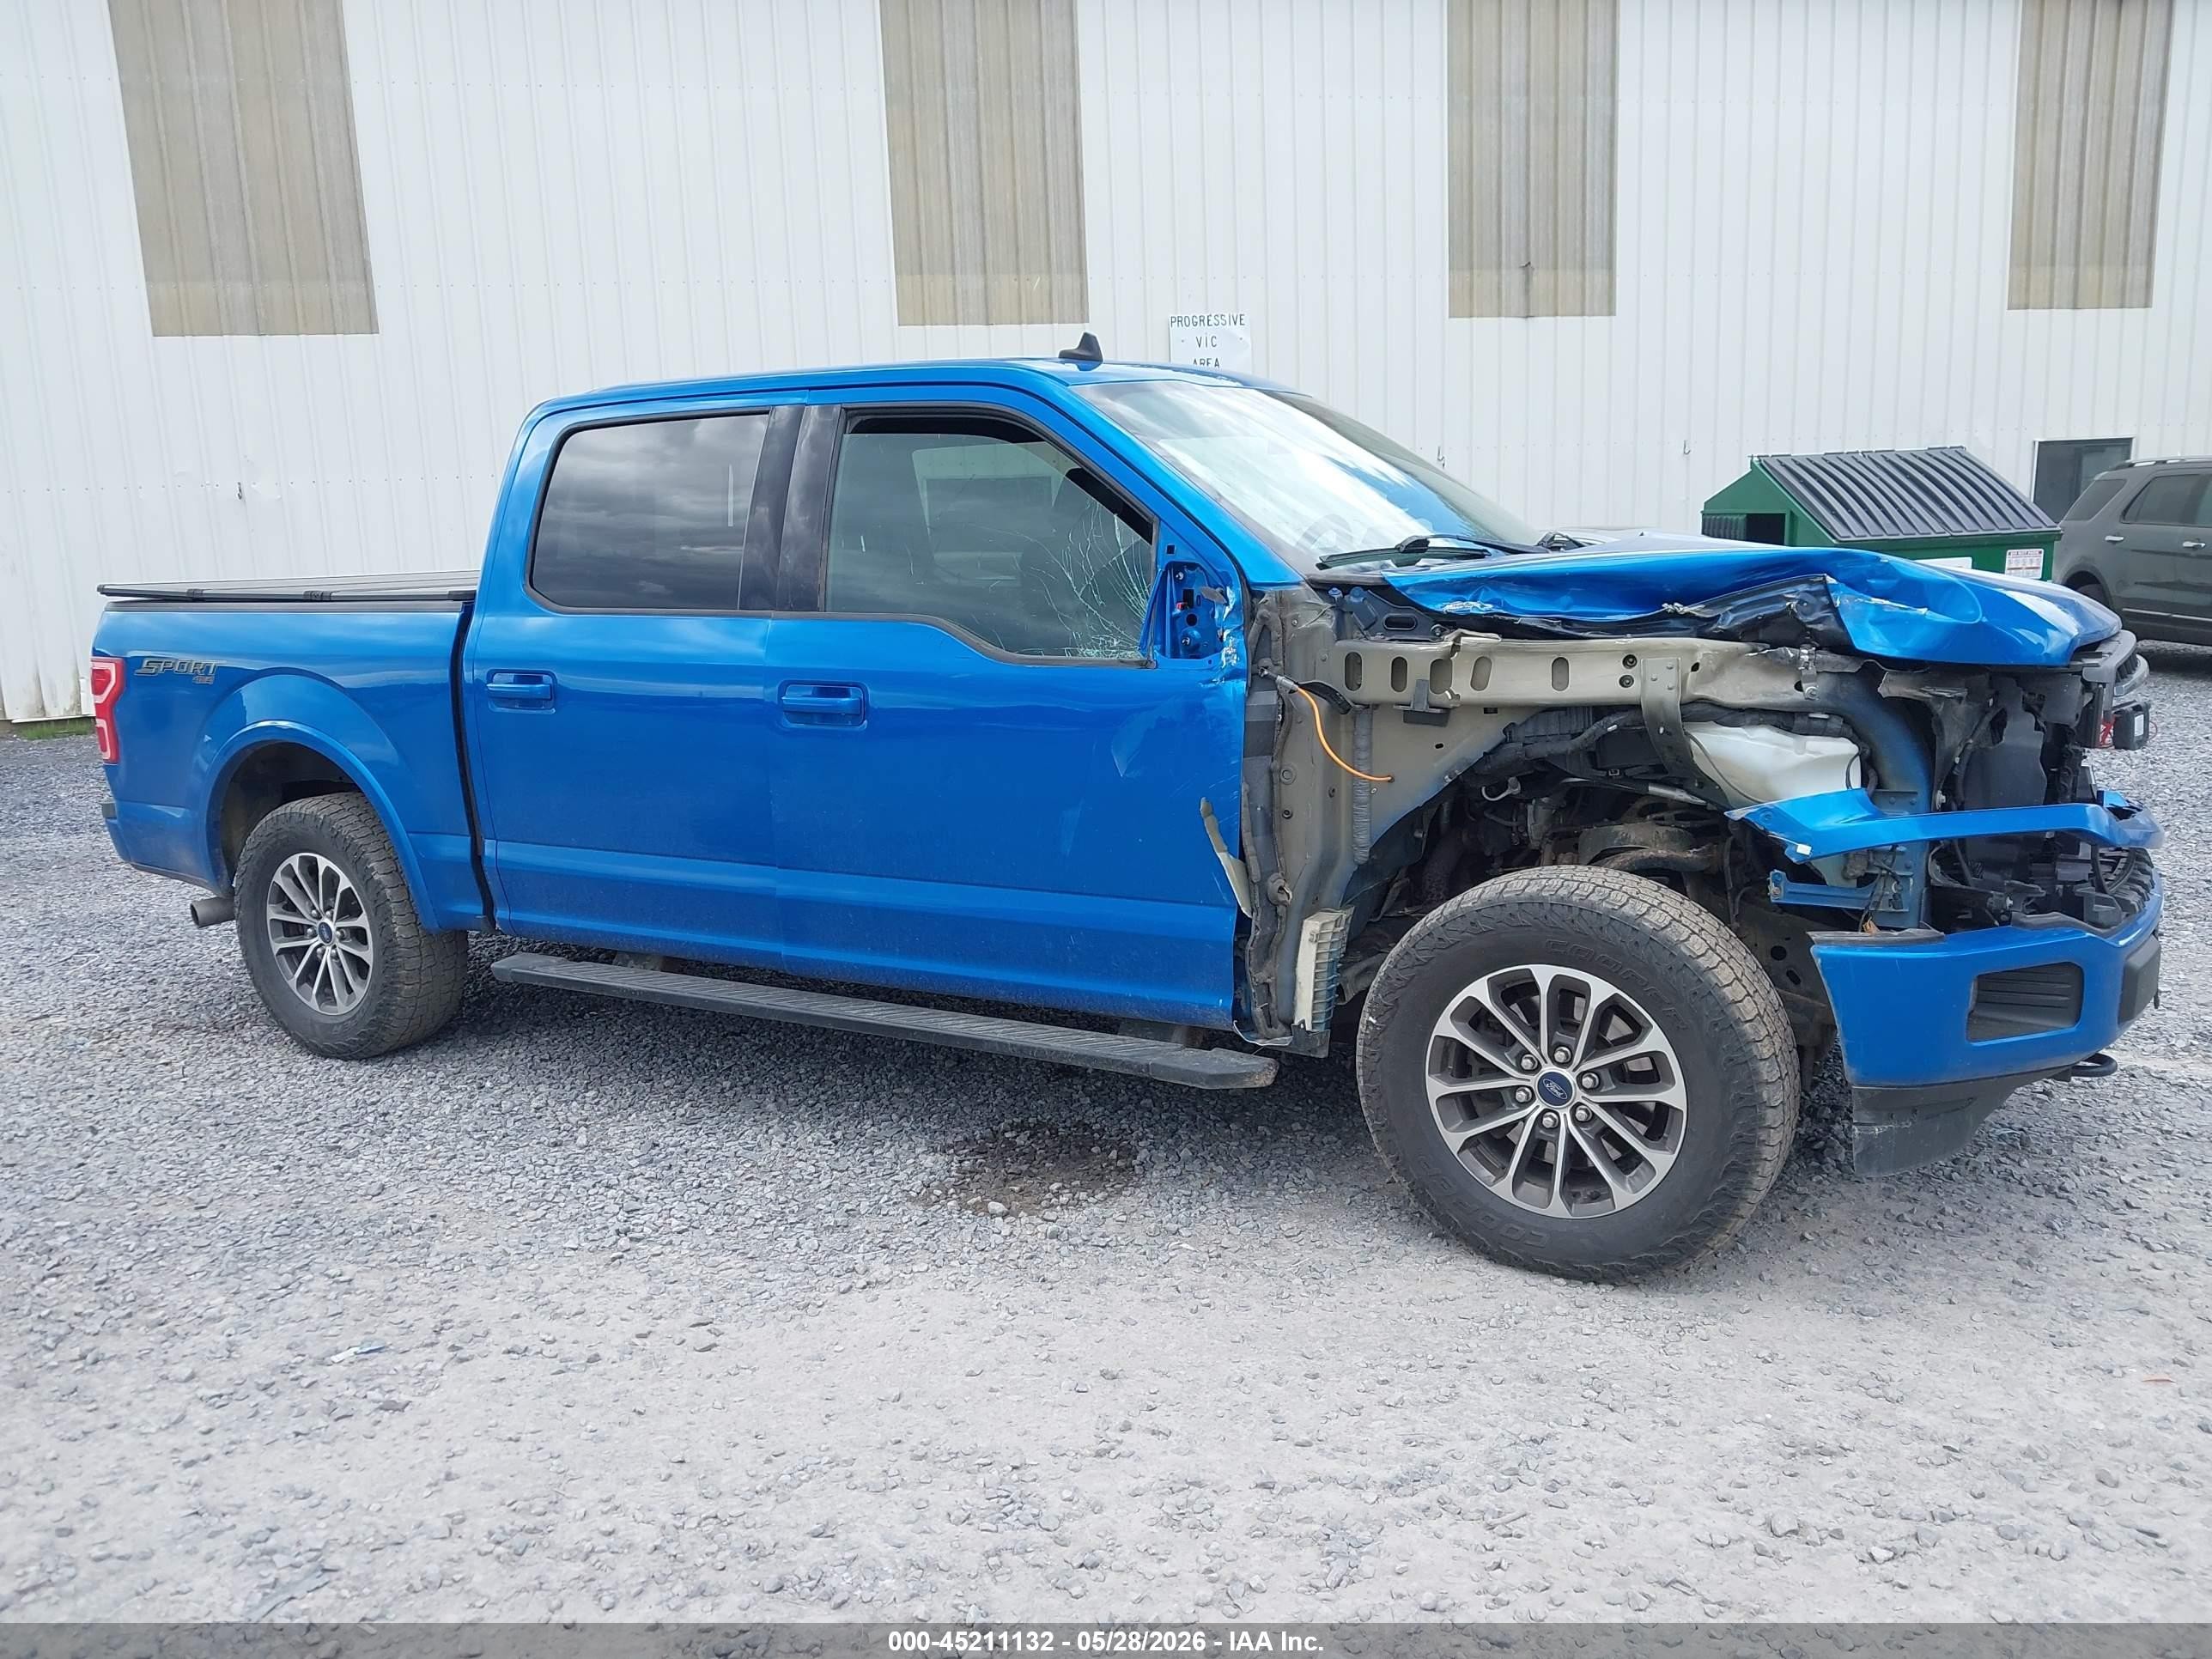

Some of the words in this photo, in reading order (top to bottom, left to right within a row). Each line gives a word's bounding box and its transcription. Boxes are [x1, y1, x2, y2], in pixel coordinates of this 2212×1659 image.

[1170, 313, 1245, 328] PROGRESSIVE
[1195, 335, 1218, 348] VIC
[134, 659, 224, 676] SPORT
